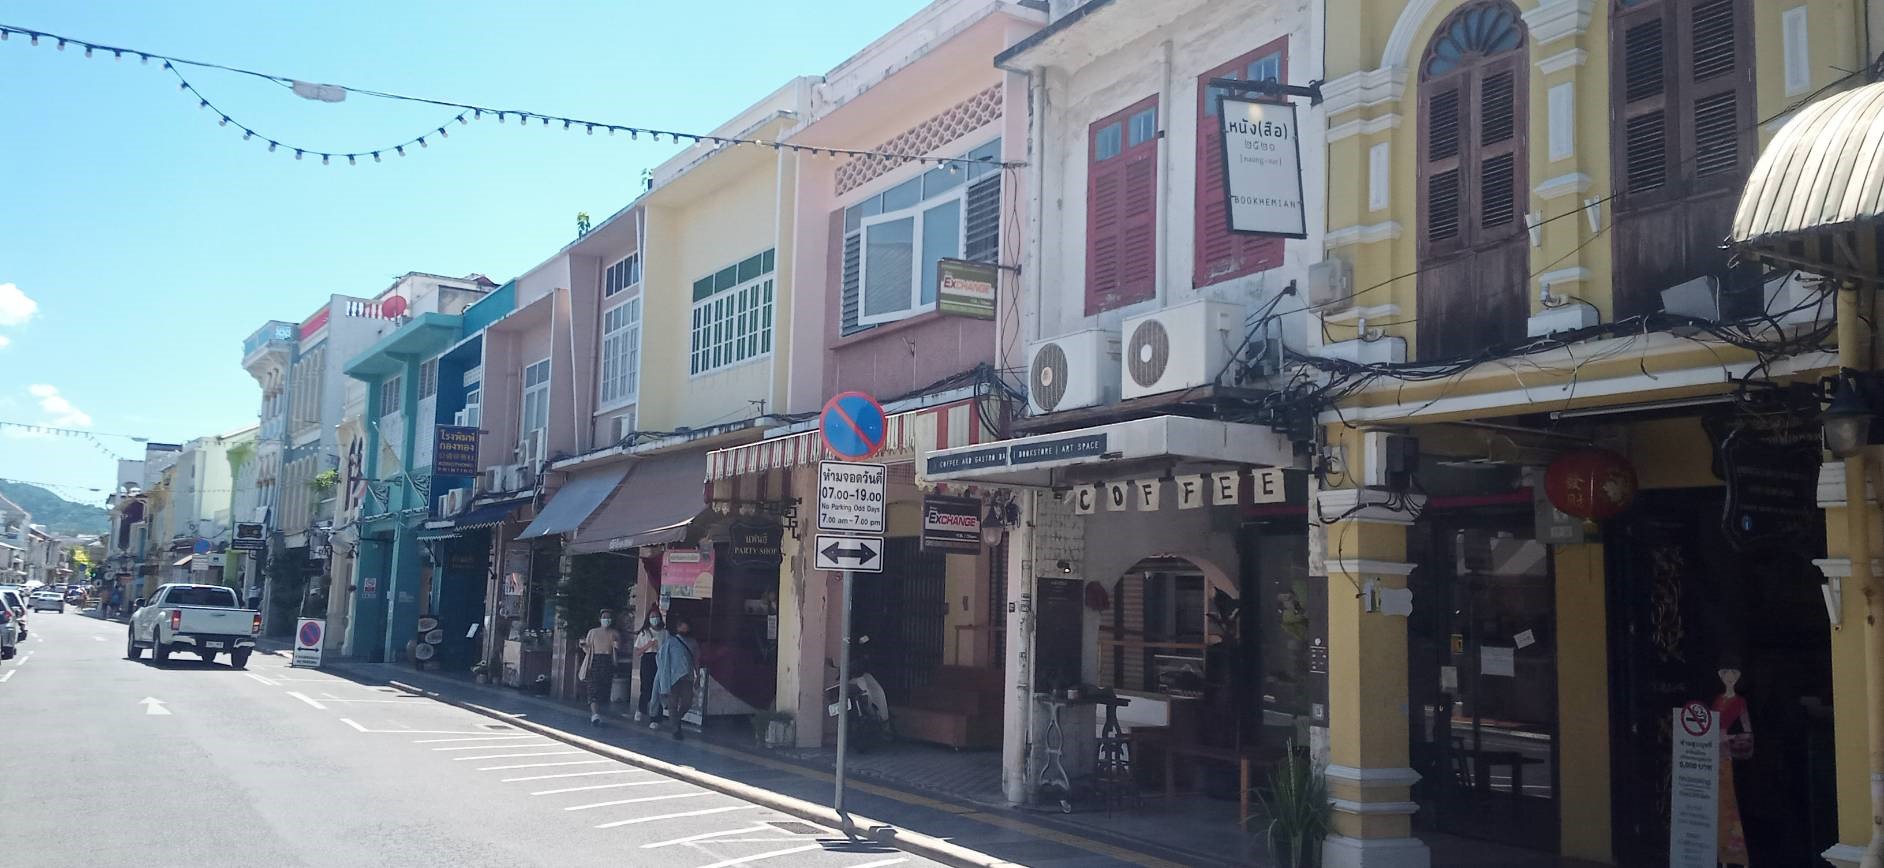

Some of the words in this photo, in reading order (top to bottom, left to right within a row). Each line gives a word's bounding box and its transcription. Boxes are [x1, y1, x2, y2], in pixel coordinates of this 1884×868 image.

[1228, 118, 1288, 140] หนัง(สือ)
[1234, 195, 1296, 209] BOOKHEMIAN
[939, 458, 959, 469] COFFEE
[961, 456, 972, 465] AND
[974, 453, 995, 463] GASTRO
[998, 451, 1008, 461] BA
[1018, 446, 1053, 459] BOOKSTORE
[1061, 444, 1074, 454] ART
[1077, 440, 1099, 451] SPACE
[822, 468, 883, 485] ห้ามจอดวันคี่
[821, 486, 882, 502] 07.00-19.00
[821, 502, 830, 510] No
[831, 503, 852, 513] Parking
[853, 504, 866, 512] Odd
[867, 505, 881, 514] Days
[821, 513, 836, 524] 7.00
[928, 511, 977, 527] EXCHANGE
[734, 546, 758, 555] PARTY
[759, 547, 777, 555] SHOP
